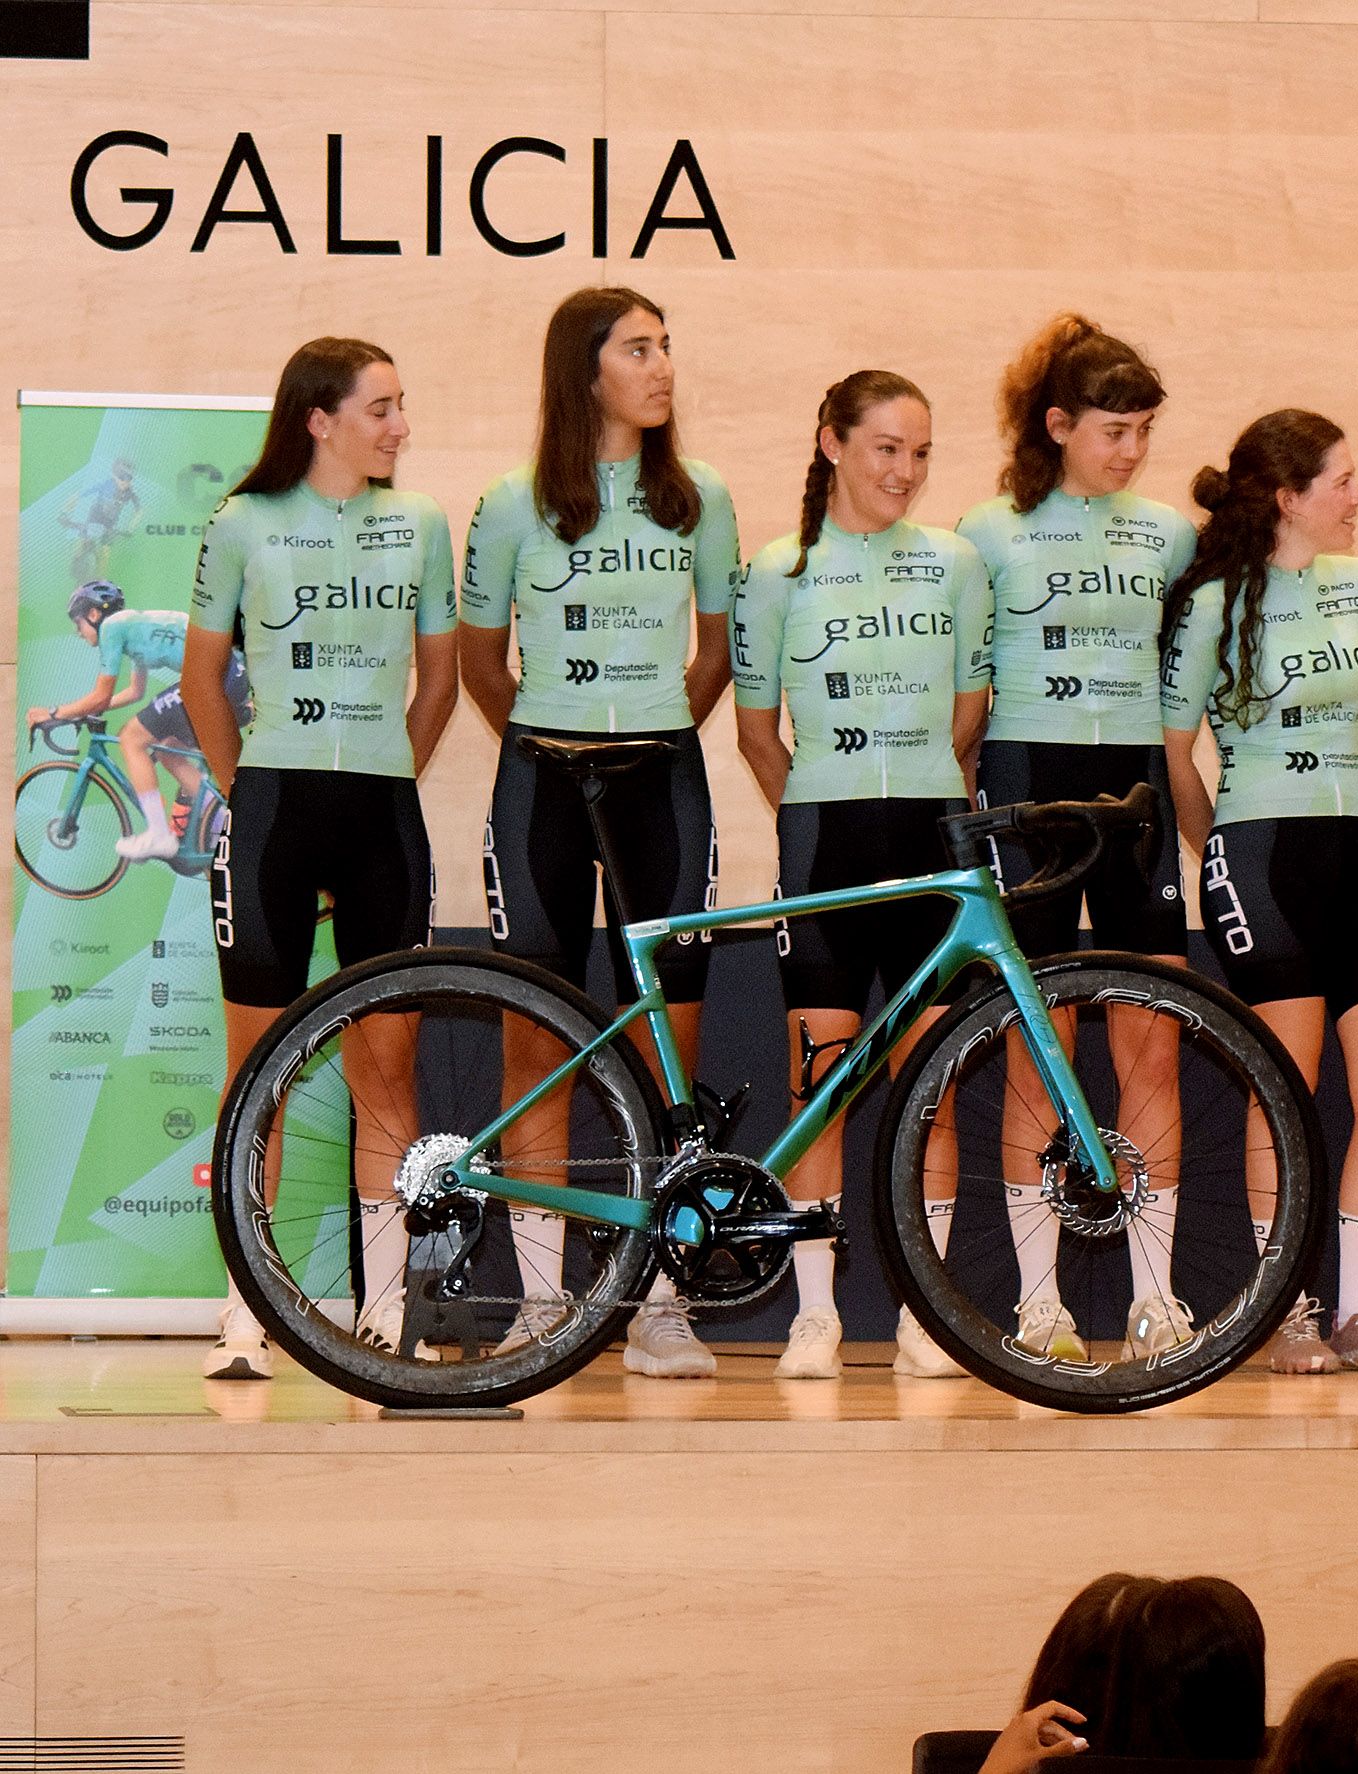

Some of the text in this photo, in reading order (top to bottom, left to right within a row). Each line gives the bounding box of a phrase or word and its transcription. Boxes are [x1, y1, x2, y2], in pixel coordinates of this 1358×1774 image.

[70, 130, 737, 260] GALICIA
[1128, 519, 1158, 529] PACTO
[284, 535, 335, 549] Kiroot
[356, 529, 414, 543] FARTO
[1029, 531, 1083, 543] Kiroot
[1104, 530, 1165, 548] FARTO
[907, 551, 936, 559] PACTO
[531, 538, 693, 593] galicia
[884, 566, 944, 577] FARTO
[813, 572, 863, 587] Kiroot
[1330, 582, 1354, 593] PACTO
[261, 576, 420, 630] galicia
[592, 606, 638, 617] XUNTA
[592, 618, 664, 630] DE GALICIA
[790, 606, 954, 663] galicia
[1071, 627, 1117, 637] XUNTA
[317, 643, 363, 655] XUNTA
[1071, 638, 1143, 651] DE GALICIA
[317, 657, 388, 669] DE GALICIA
[604, 663, 658, 673] Deputación
[604, 672, 658, 682] Pontevedra
[854, 672, 902, 684] XUNTA
[854, 684, 930, 696] DE GALICIA
[1088, 679, 1143, 690] Deputación
[1088, 688, 1143, 698] Pontevedra
[1305, 701, 1343, 714] XUNTA
[1304, 713, 1320, 724] DE
[1205, 834, 1253, 955] FARTO
[55, 1031, 110, 1044] ABANCA
